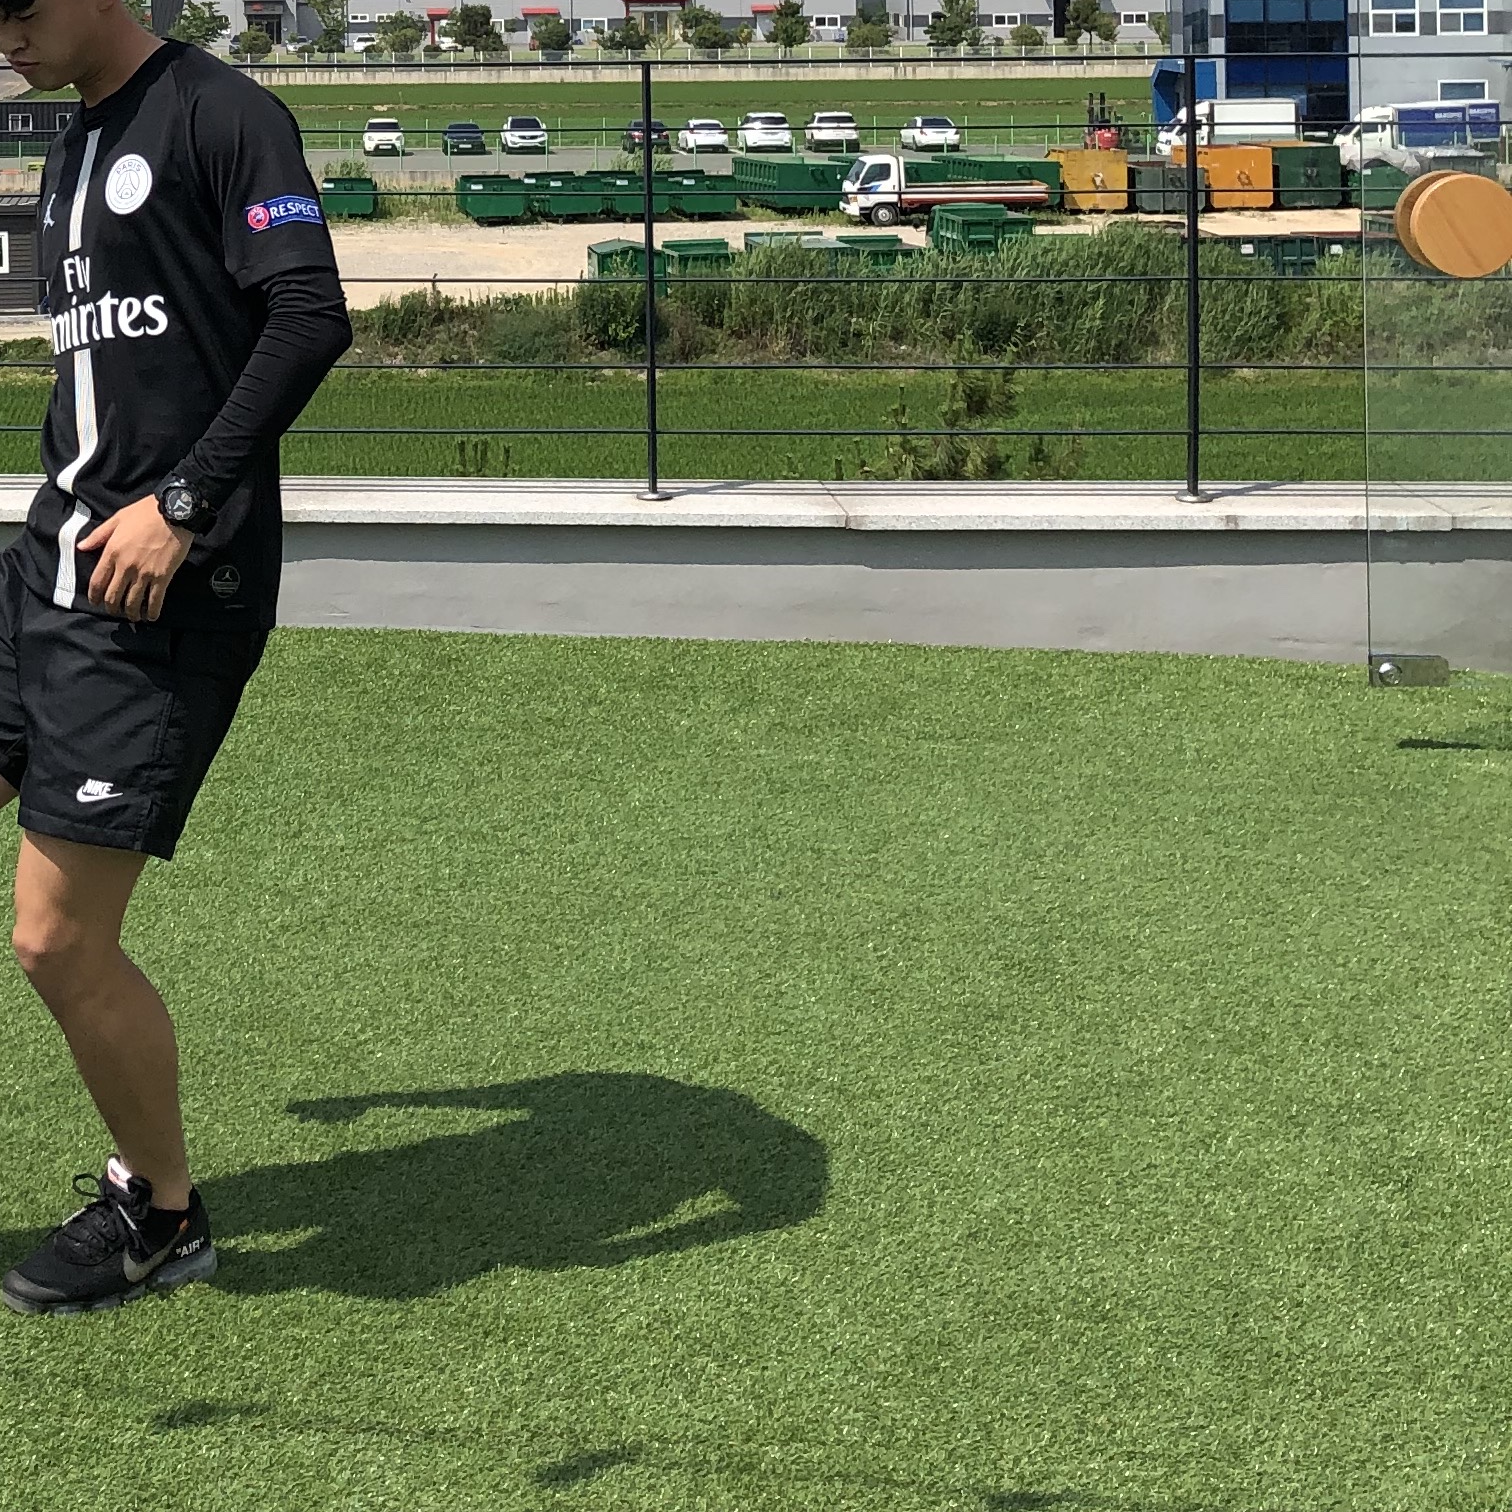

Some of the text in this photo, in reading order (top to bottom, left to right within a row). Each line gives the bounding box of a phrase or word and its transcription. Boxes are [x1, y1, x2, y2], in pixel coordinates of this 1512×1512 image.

[115, 161, 142, 175] PARIS
[269, 202, 320, 219] RESPECT
[62, 254, 90, 293] Fly
[51, 290, 168, 356] mirates
[82, 778, 114, 796] NIKE
